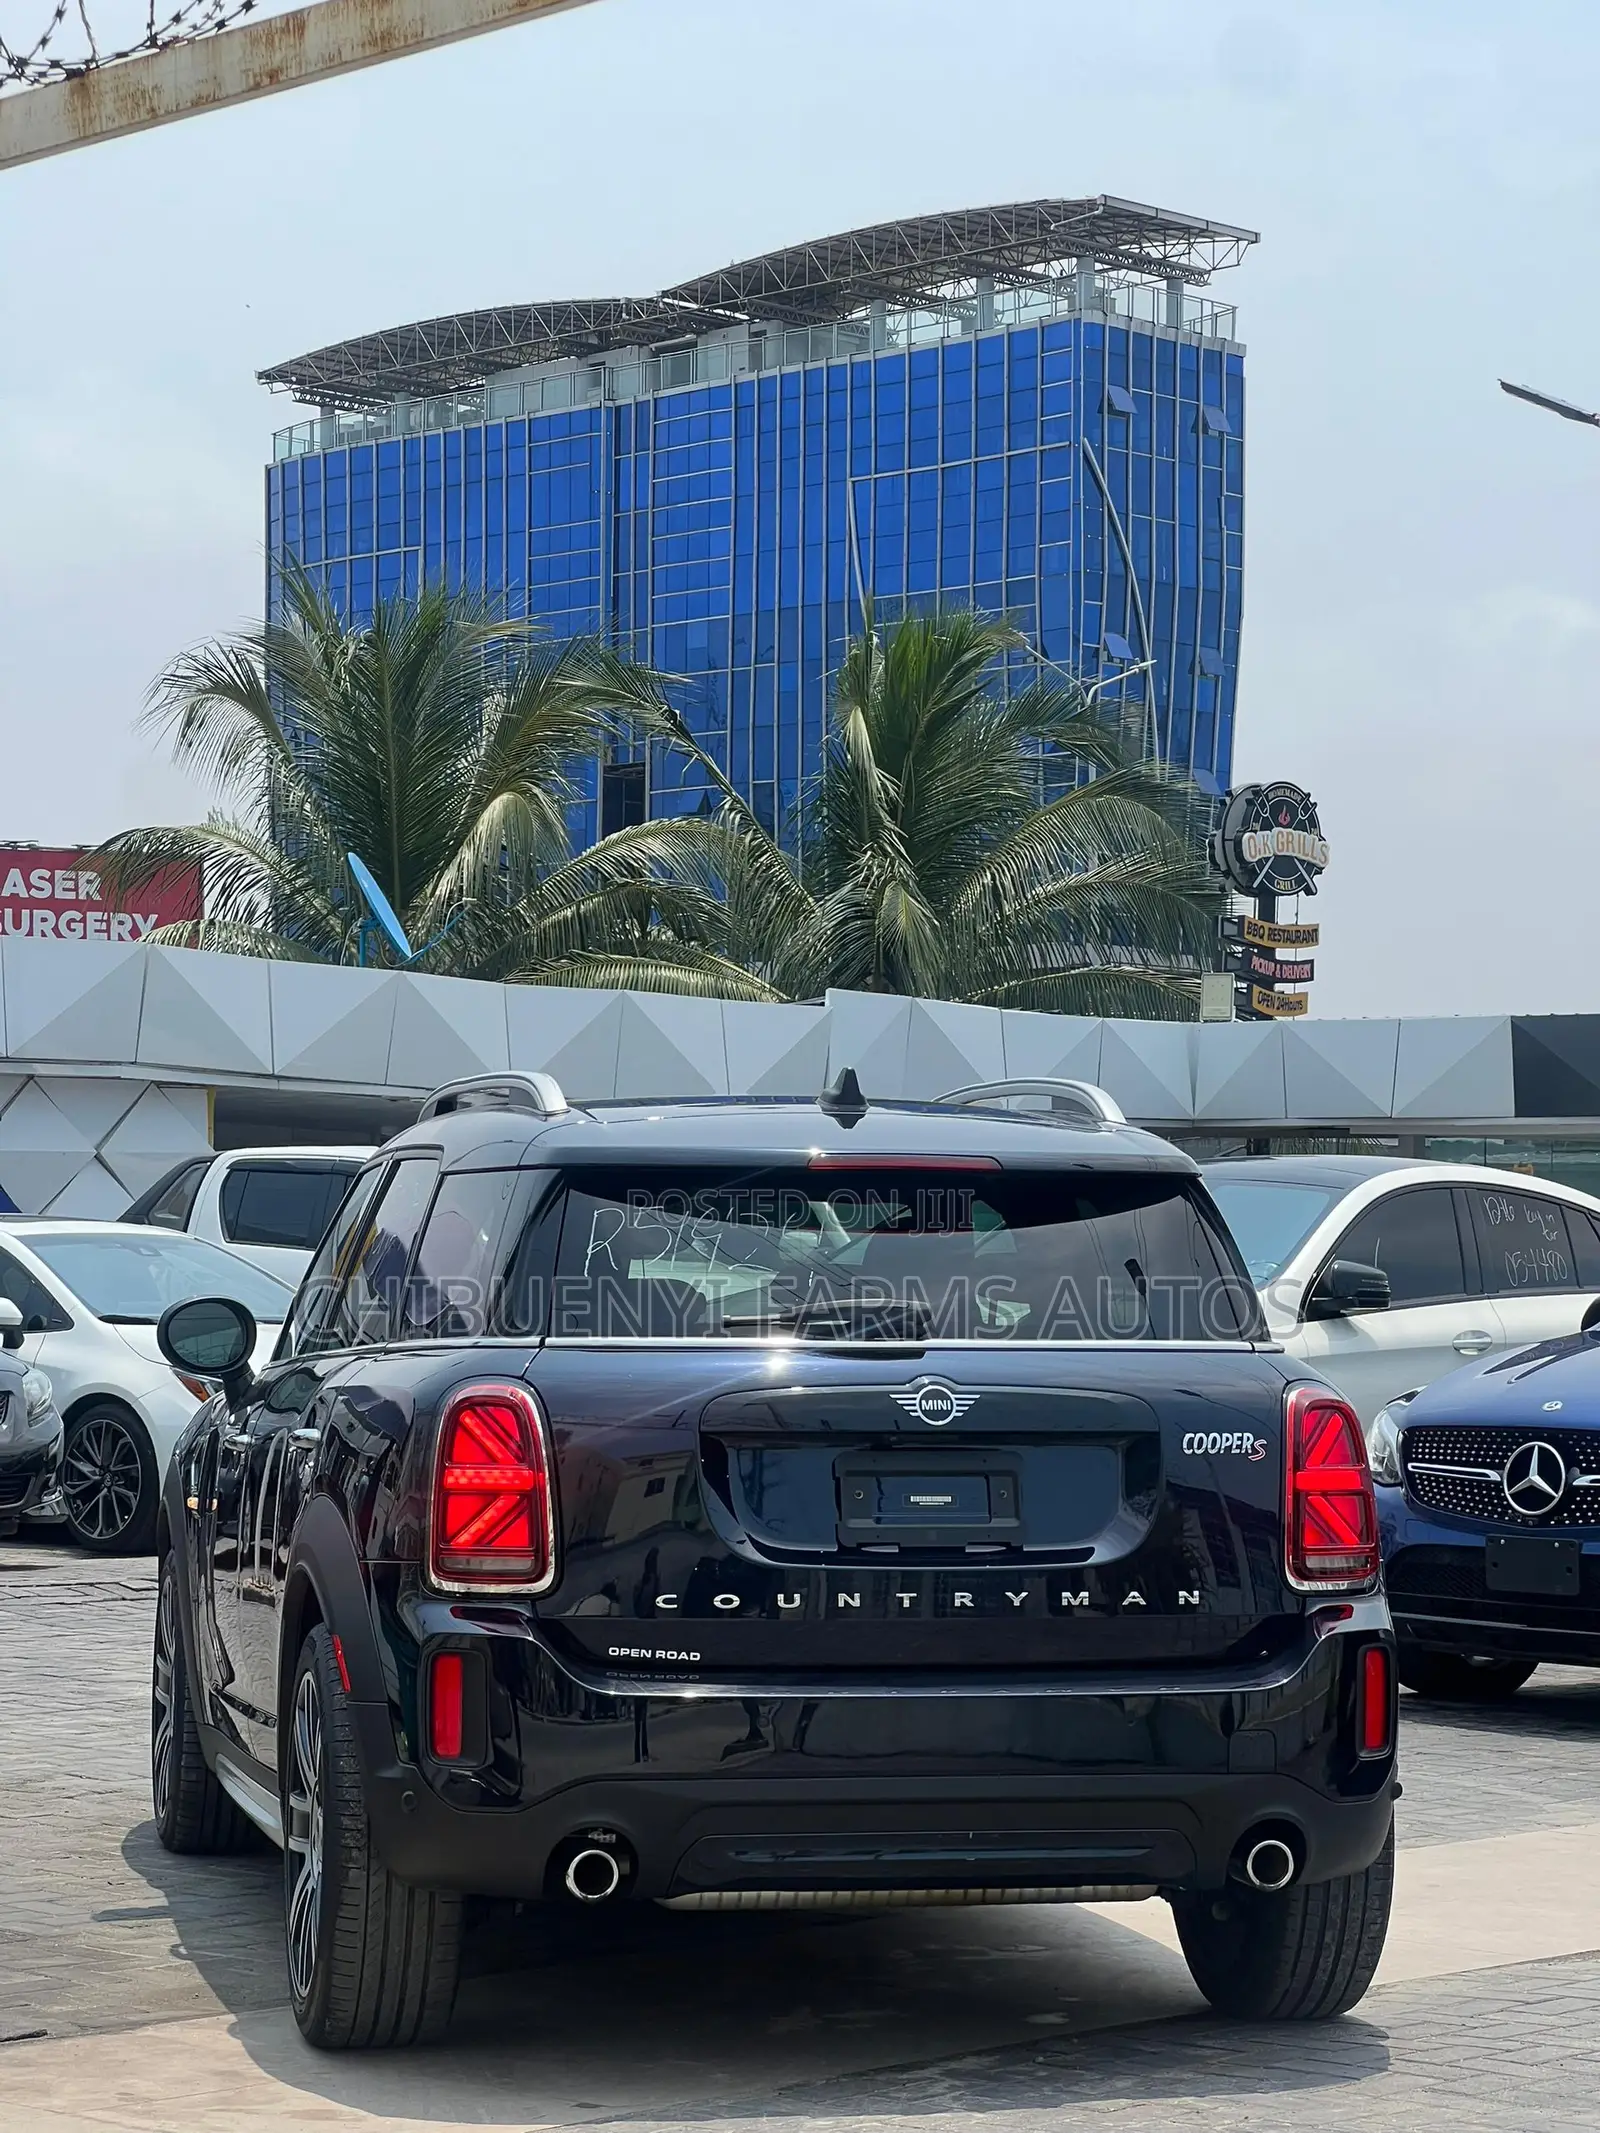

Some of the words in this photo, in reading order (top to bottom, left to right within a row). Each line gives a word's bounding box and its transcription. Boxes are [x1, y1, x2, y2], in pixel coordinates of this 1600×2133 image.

[1276, 830, 1328, 865] GRILLS
[1274, 878, 1298, 891] GRILL
[0, 908, 158, 941] URGERY
[1246, 921, 1265, 940] BBQ
[1267, 927, 1319, 944] RESTAURANT
[1251, 955, 1275, 976] PICKUP
[1275, 963, 1281, 978] &
[1282, 963, 1312, 979] DELIVERY
[1257, 990, 1275, 1010] OPEN
[921, 1399, 951, 1411] MINI
[655, 1590, 1200, 1609] COUNTRYMAN
[608, 1646, 652, 1658] OPEN
[655, 1650, 701, 1661] ROAD
